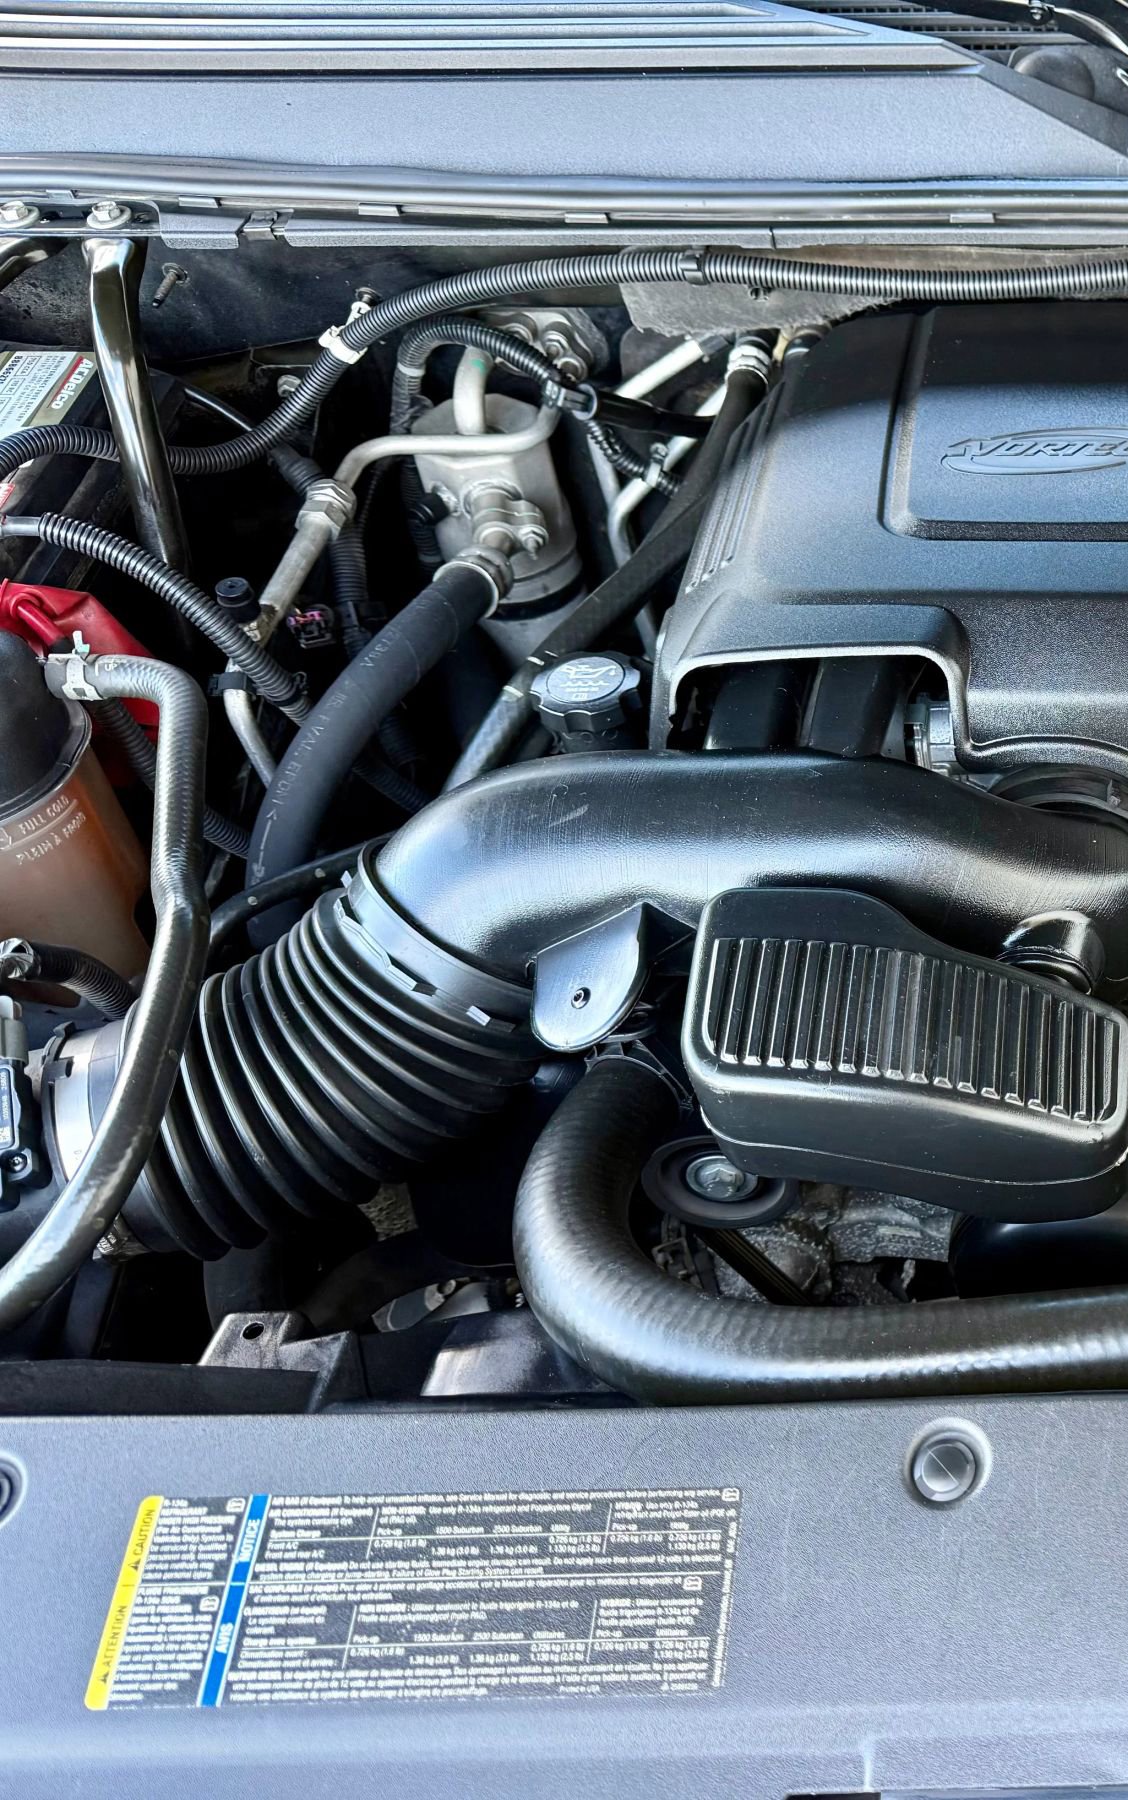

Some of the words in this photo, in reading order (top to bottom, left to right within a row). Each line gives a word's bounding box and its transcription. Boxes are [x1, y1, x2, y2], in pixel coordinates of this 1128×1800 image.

[51, 358, 94, 409] ACDelco
[18, 814, 46, 835] FULL
[46, 794, 70, 817] COLD
[133, 1509, 156, 1556] CAUTION
[239, 1518, 261, 1562] NOTICE
[102, 1605, 128, 1667] ATTENTION
[216, 1622, 234, 1654] AVIS
